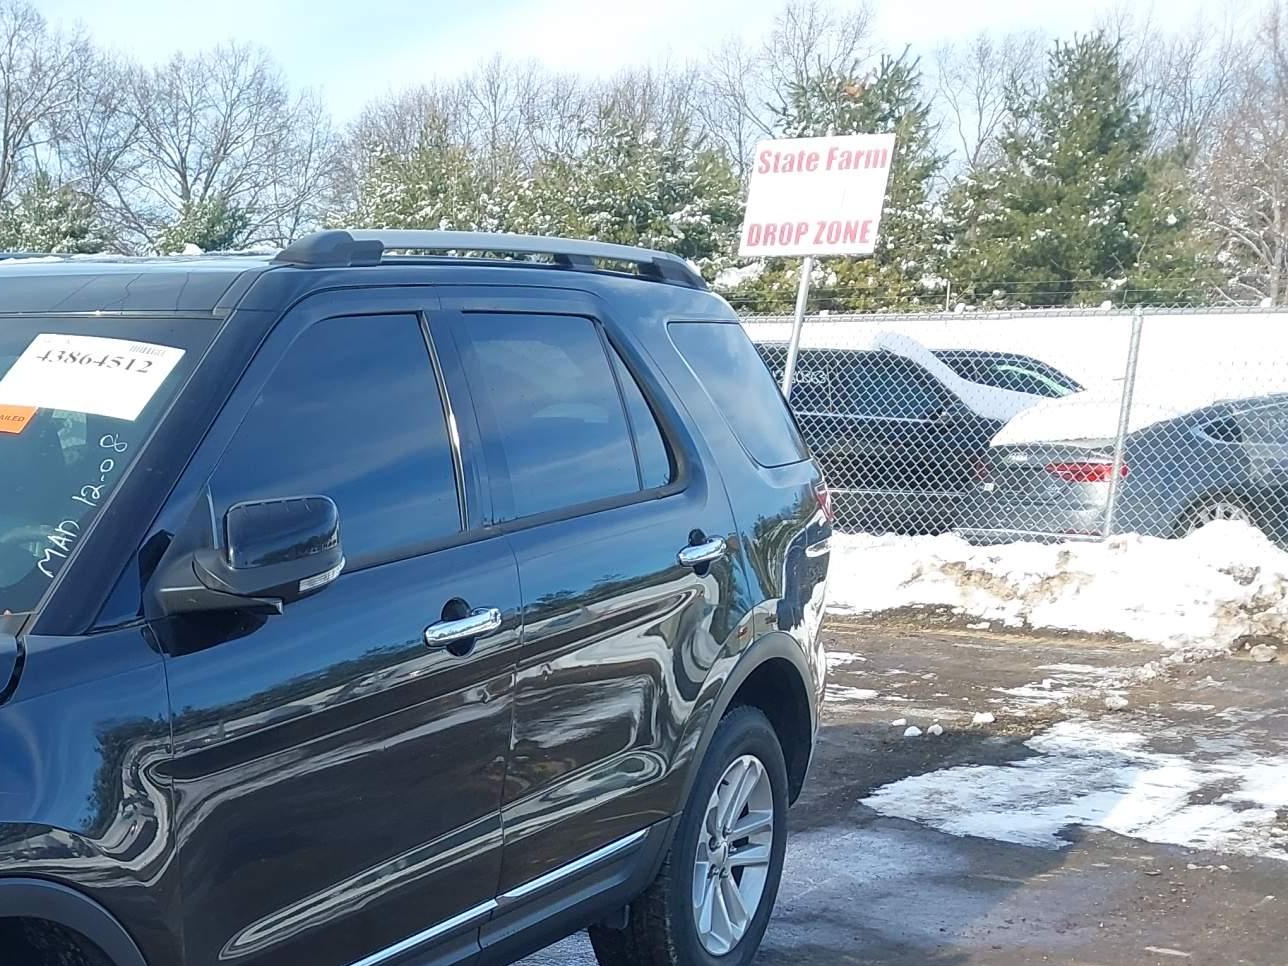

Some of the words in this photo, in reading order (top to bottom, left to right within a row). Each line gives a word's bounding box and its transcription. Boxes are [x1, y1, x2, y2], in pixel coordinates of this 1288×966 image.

[758, 148, 820, 174] State
[825, 147, 888, 171] Farm
[746, 221, 809, 247] DROP
[812, 220, 873, 245] ZONE
[36, 350, 153, 374] 43864512
